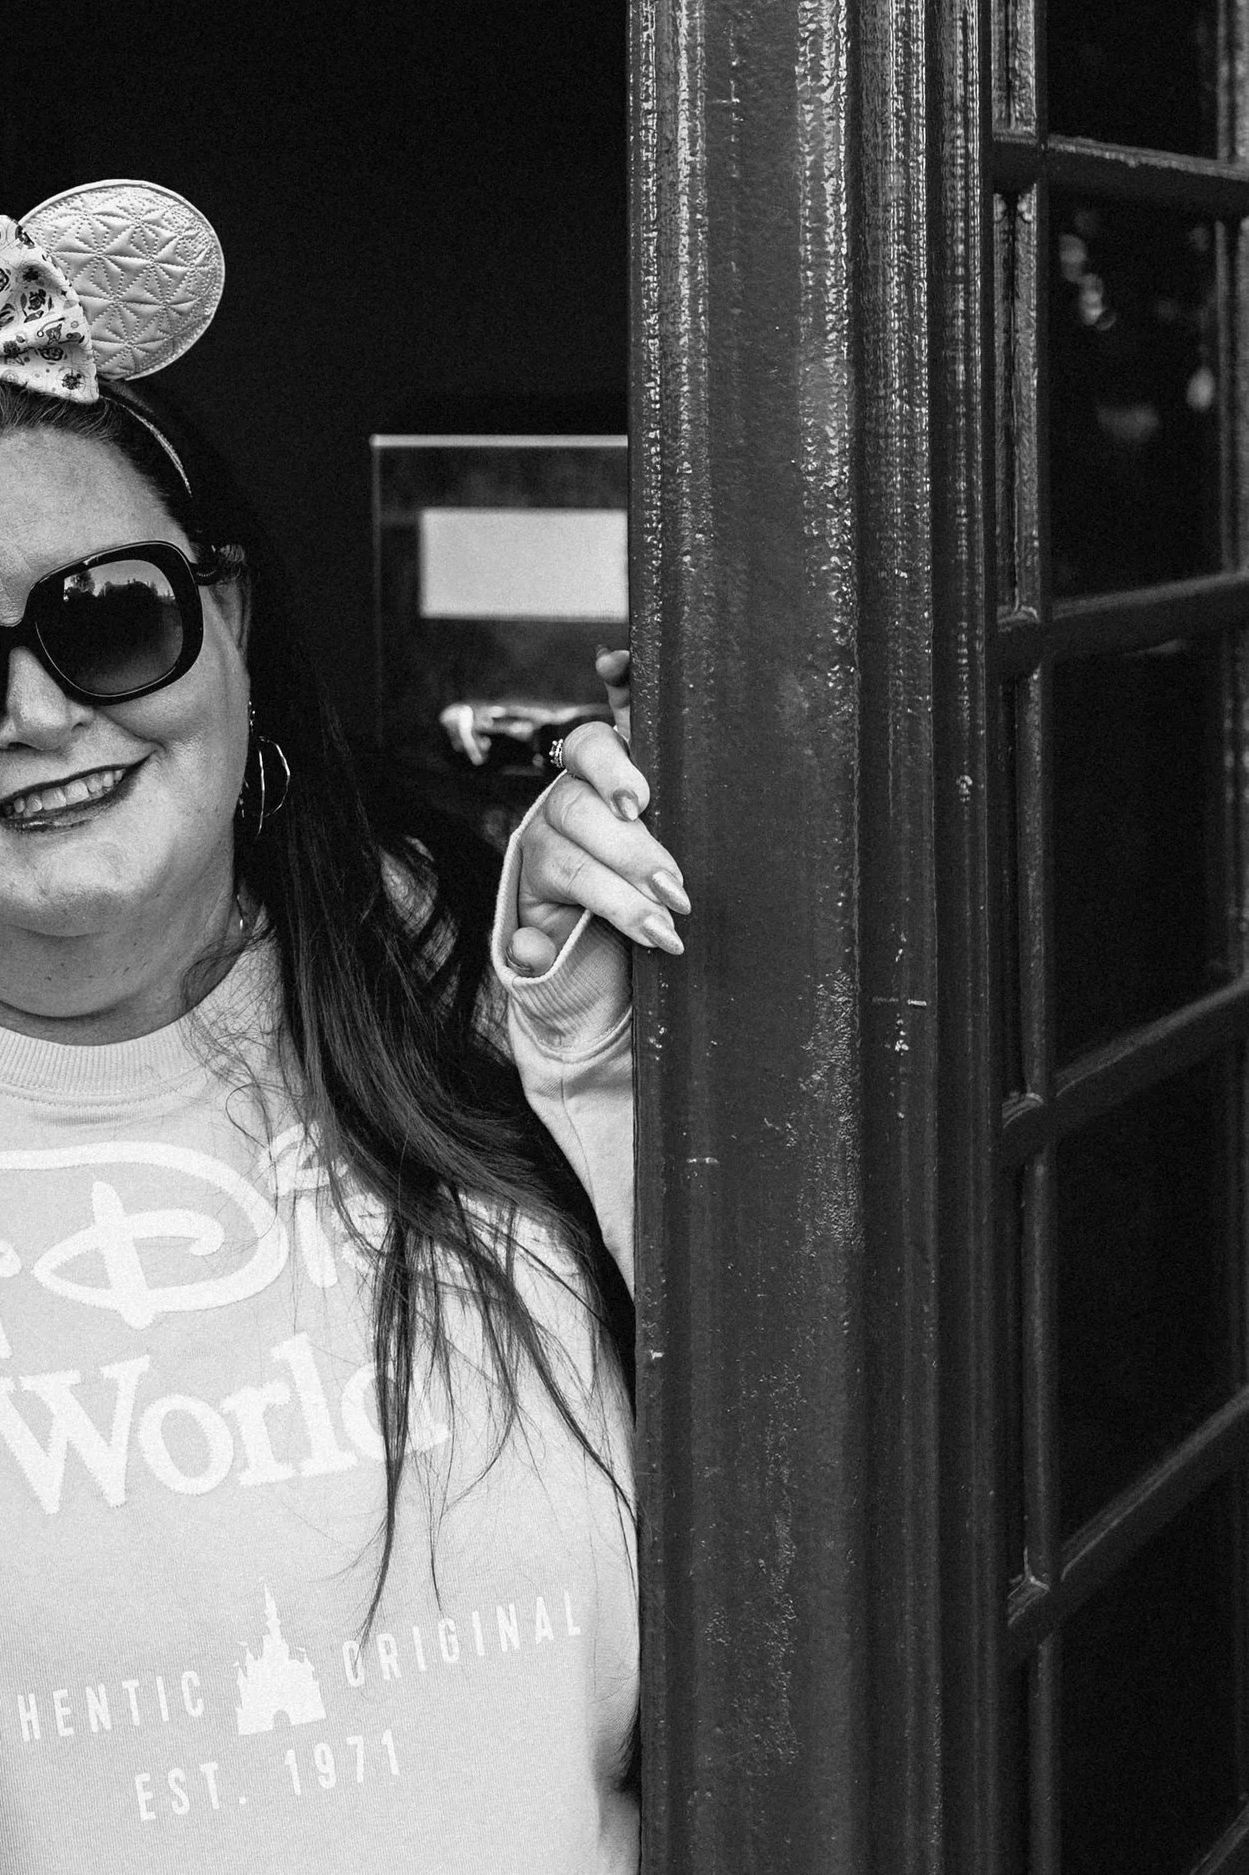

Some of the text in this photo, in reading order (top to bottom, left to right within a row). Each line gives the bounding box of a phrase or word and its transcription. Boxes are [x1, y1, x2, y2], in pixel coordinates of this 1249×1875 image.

[341, 1589, 582, 1689] ORIGINAL
[134, 1728, 401, 1823] EST. 1971
